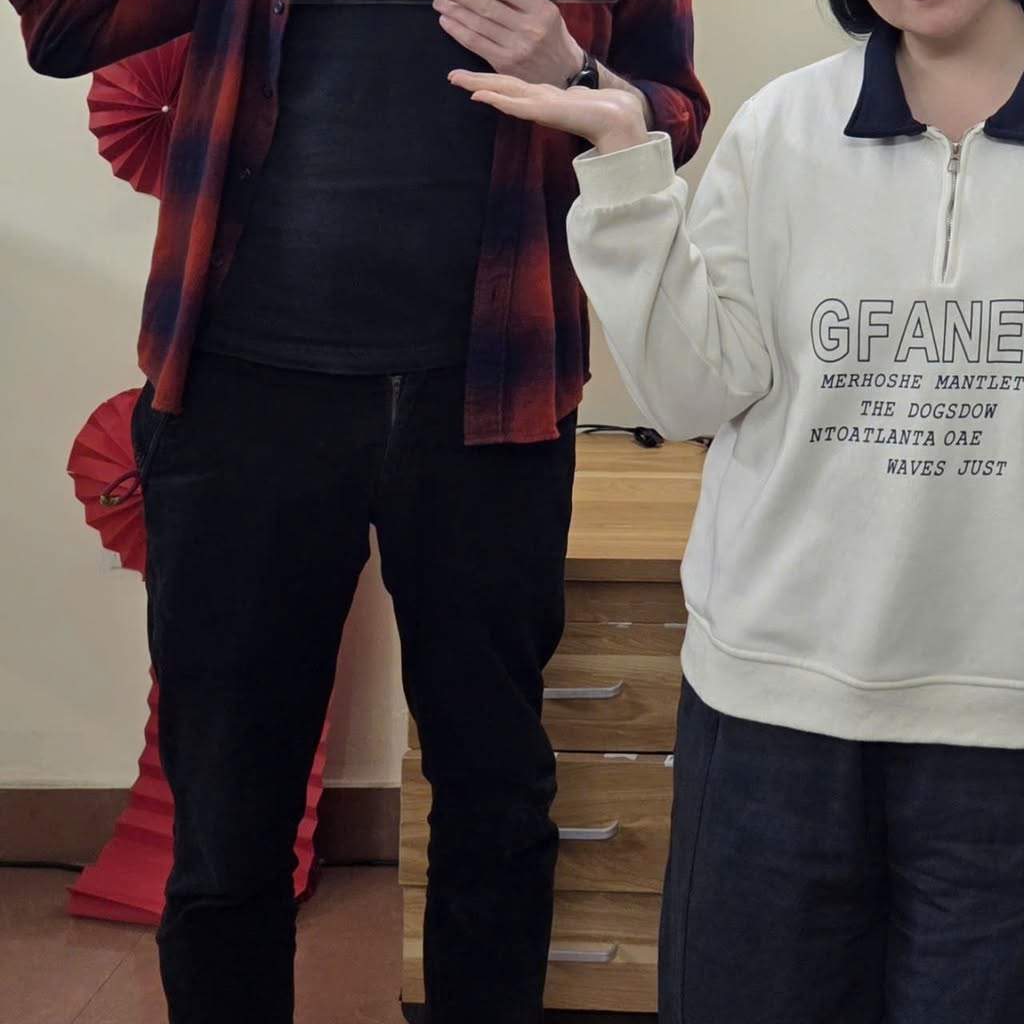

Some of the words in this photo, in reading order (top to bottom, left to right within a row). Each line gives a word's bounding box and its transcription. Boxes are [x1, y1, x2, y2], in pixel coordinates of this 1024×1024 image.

[821, 373, 923, 389] MERHOSHE
[935, 375, 1024, 391] MANTLET
[860, 400, 896, 417] THE
[907, 403, 998, 419] DOGSDOW
[809, 426, 936, 446] NTOATLANTA
[943, 430, 983, 446] OAE
[887, 458, 946, 476] WAVES
[958, 460, 1007, 476] JUST
